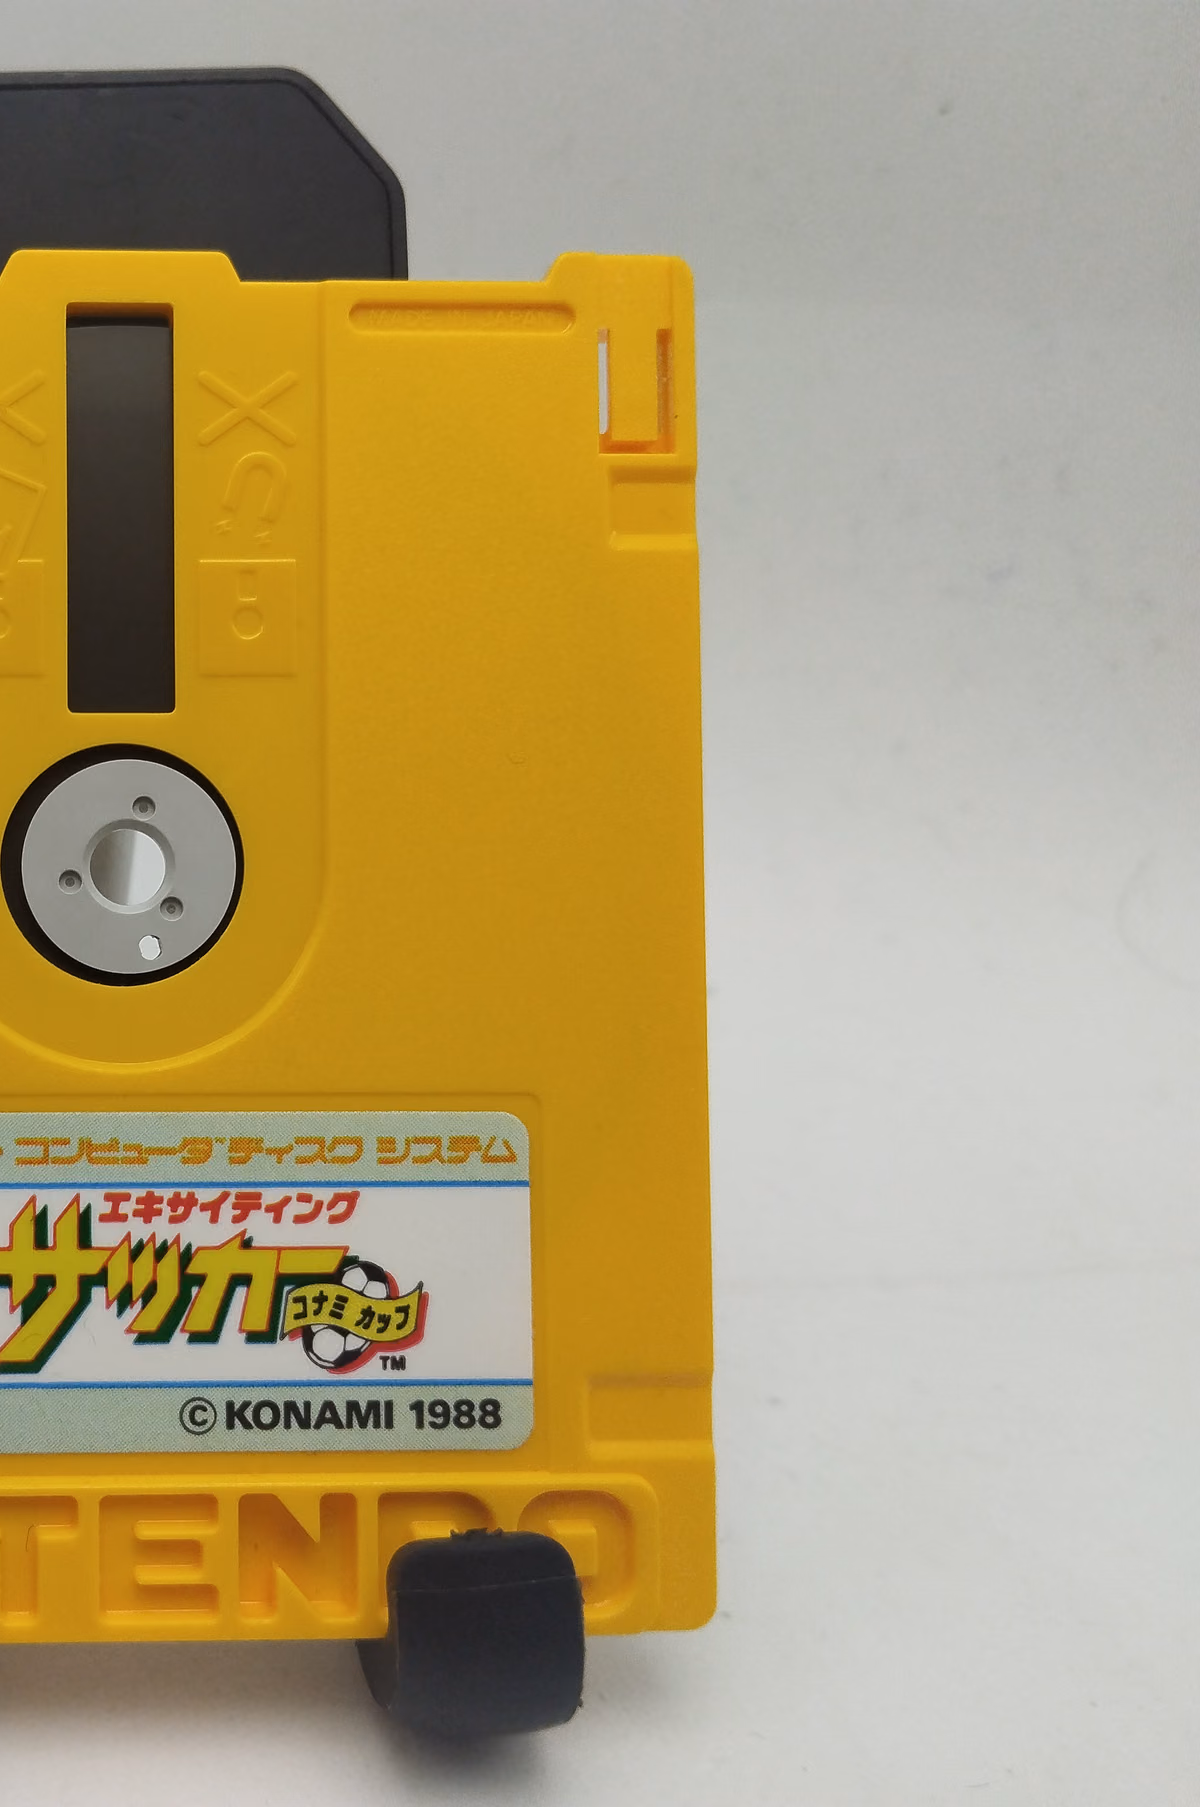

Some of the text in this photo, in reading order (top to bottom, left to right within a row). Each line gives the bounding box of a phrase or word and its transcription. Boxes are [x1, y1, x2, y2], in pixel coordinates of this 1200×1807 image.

[376, 1134, 518, 1165] システム
[98, 1189, 361, 1225] エキサイティング
[291, 1289, 412, 1334] コナミ カップ
[409, 1399, 503, 1430] 1988
